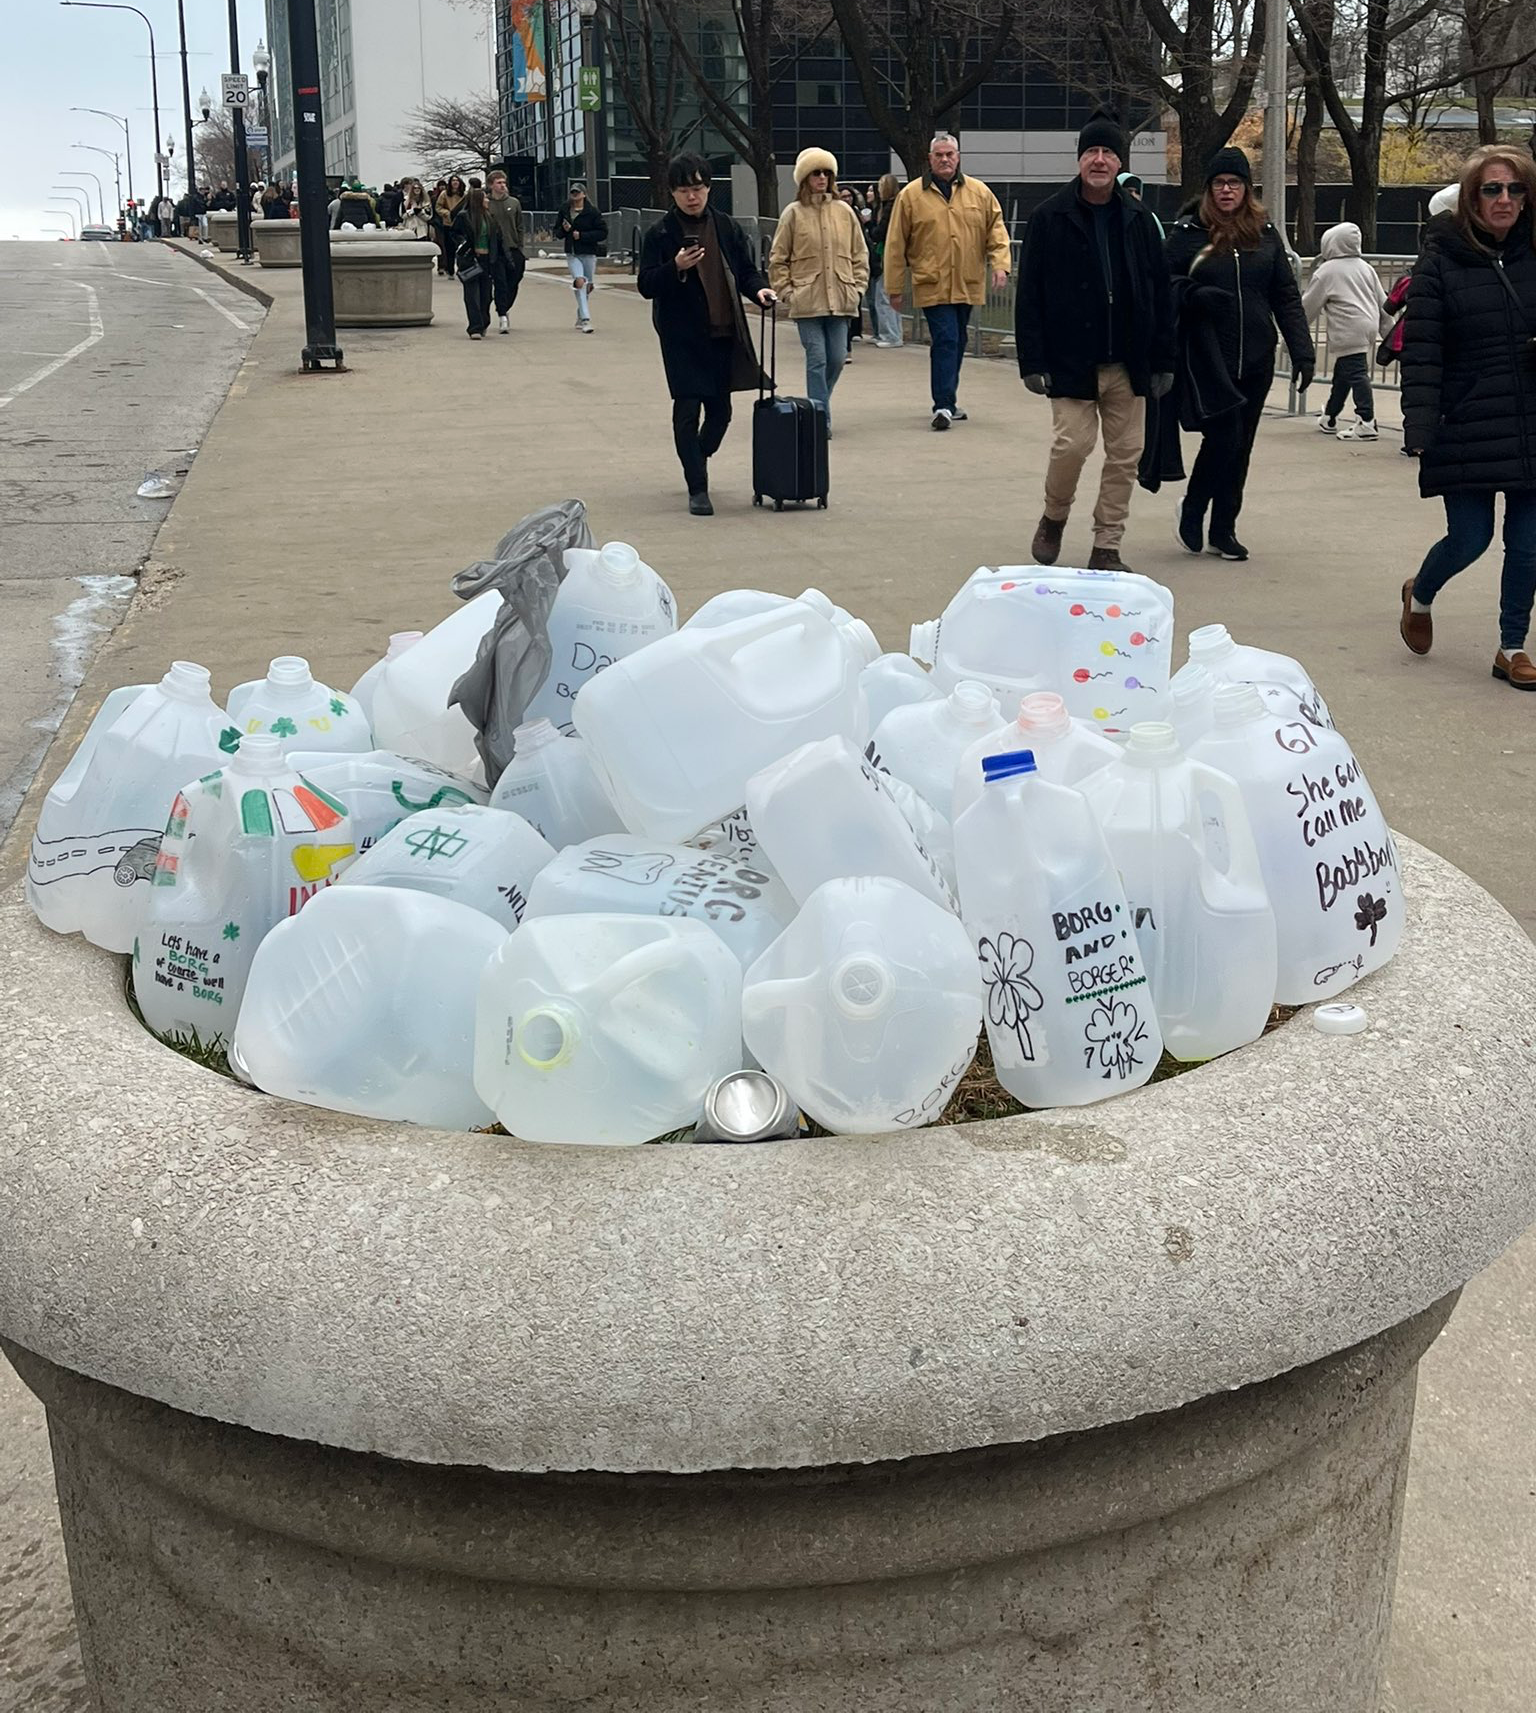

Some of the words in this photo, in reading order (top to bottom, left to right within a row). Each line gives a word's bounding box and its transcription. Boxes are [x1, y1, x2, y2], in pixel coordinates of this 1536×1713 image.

[226, 91, 246, 103] 20
[1275, 722, 1318, 754] 67
[1286, 773, 1335, 818] She
[1052, 902, 1112, 941] BORG
[168, 949, 209, 976] BORG
[185, 940, 209, 961] have
[212, 953, 221, 964] a
[1065, 934, 1115, 964] AND
[1068, 955, 1134, 993] BORGER
[177, 982, 185, 991] a
[192, 985, 223, 1006] BORG
